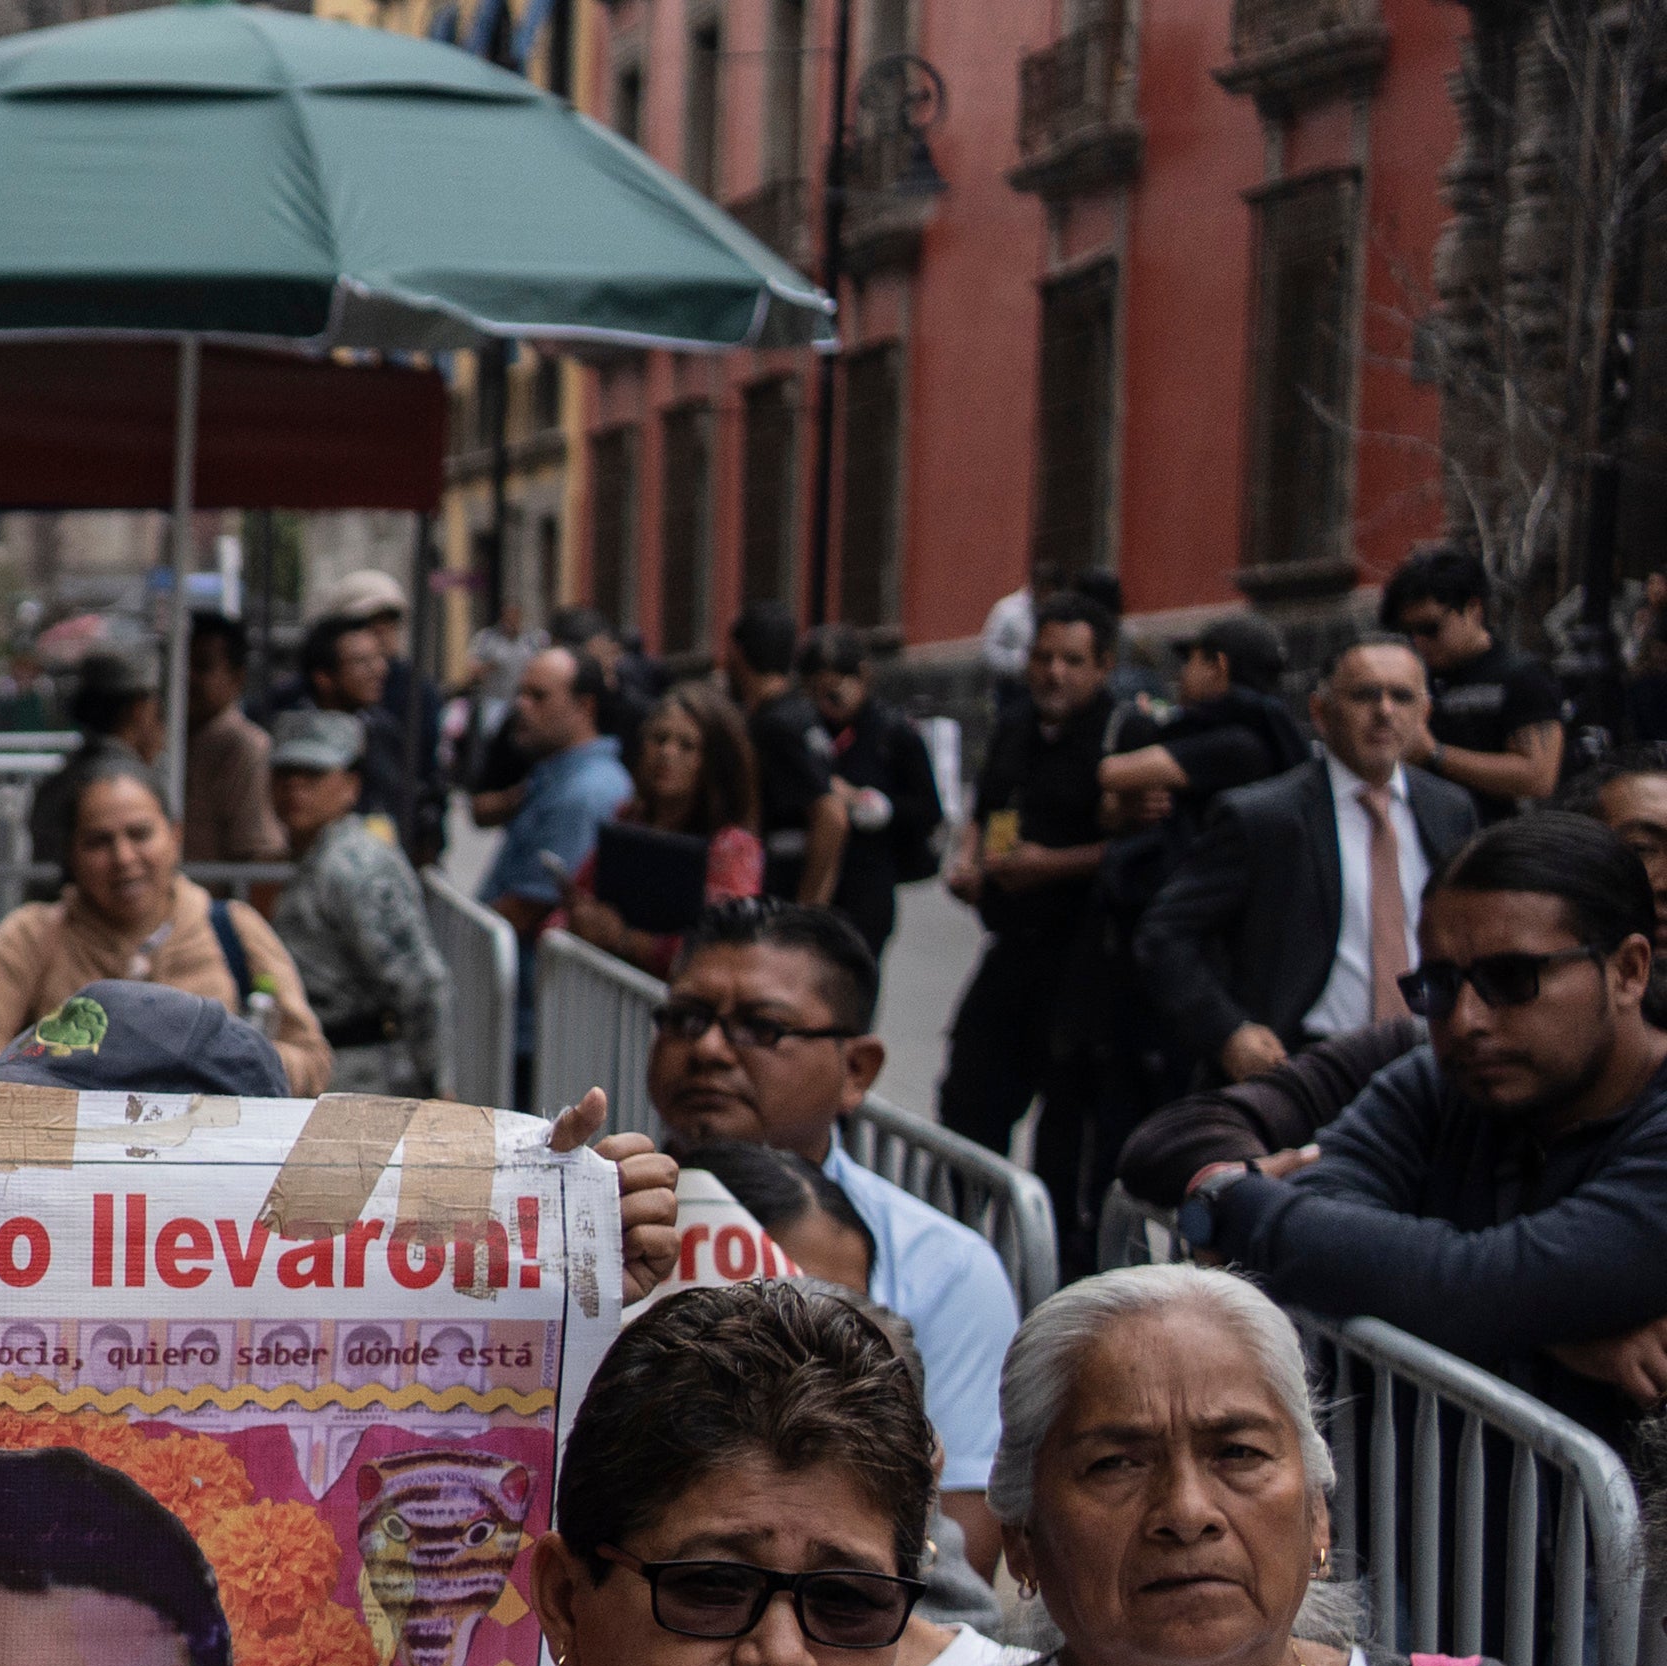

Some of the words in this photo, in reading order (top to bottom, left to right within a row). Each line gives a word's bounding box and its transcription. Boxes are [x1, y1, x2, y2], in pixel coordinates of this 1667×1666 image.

[93, 1195, 539, 1288] llevaron!
[107, 1341, 219, 1373] quiero
[237, 1341, 329, 1368] saber
[347, 1338, 441, 1367] dónde
[458, 1340, 533, 1368] está
